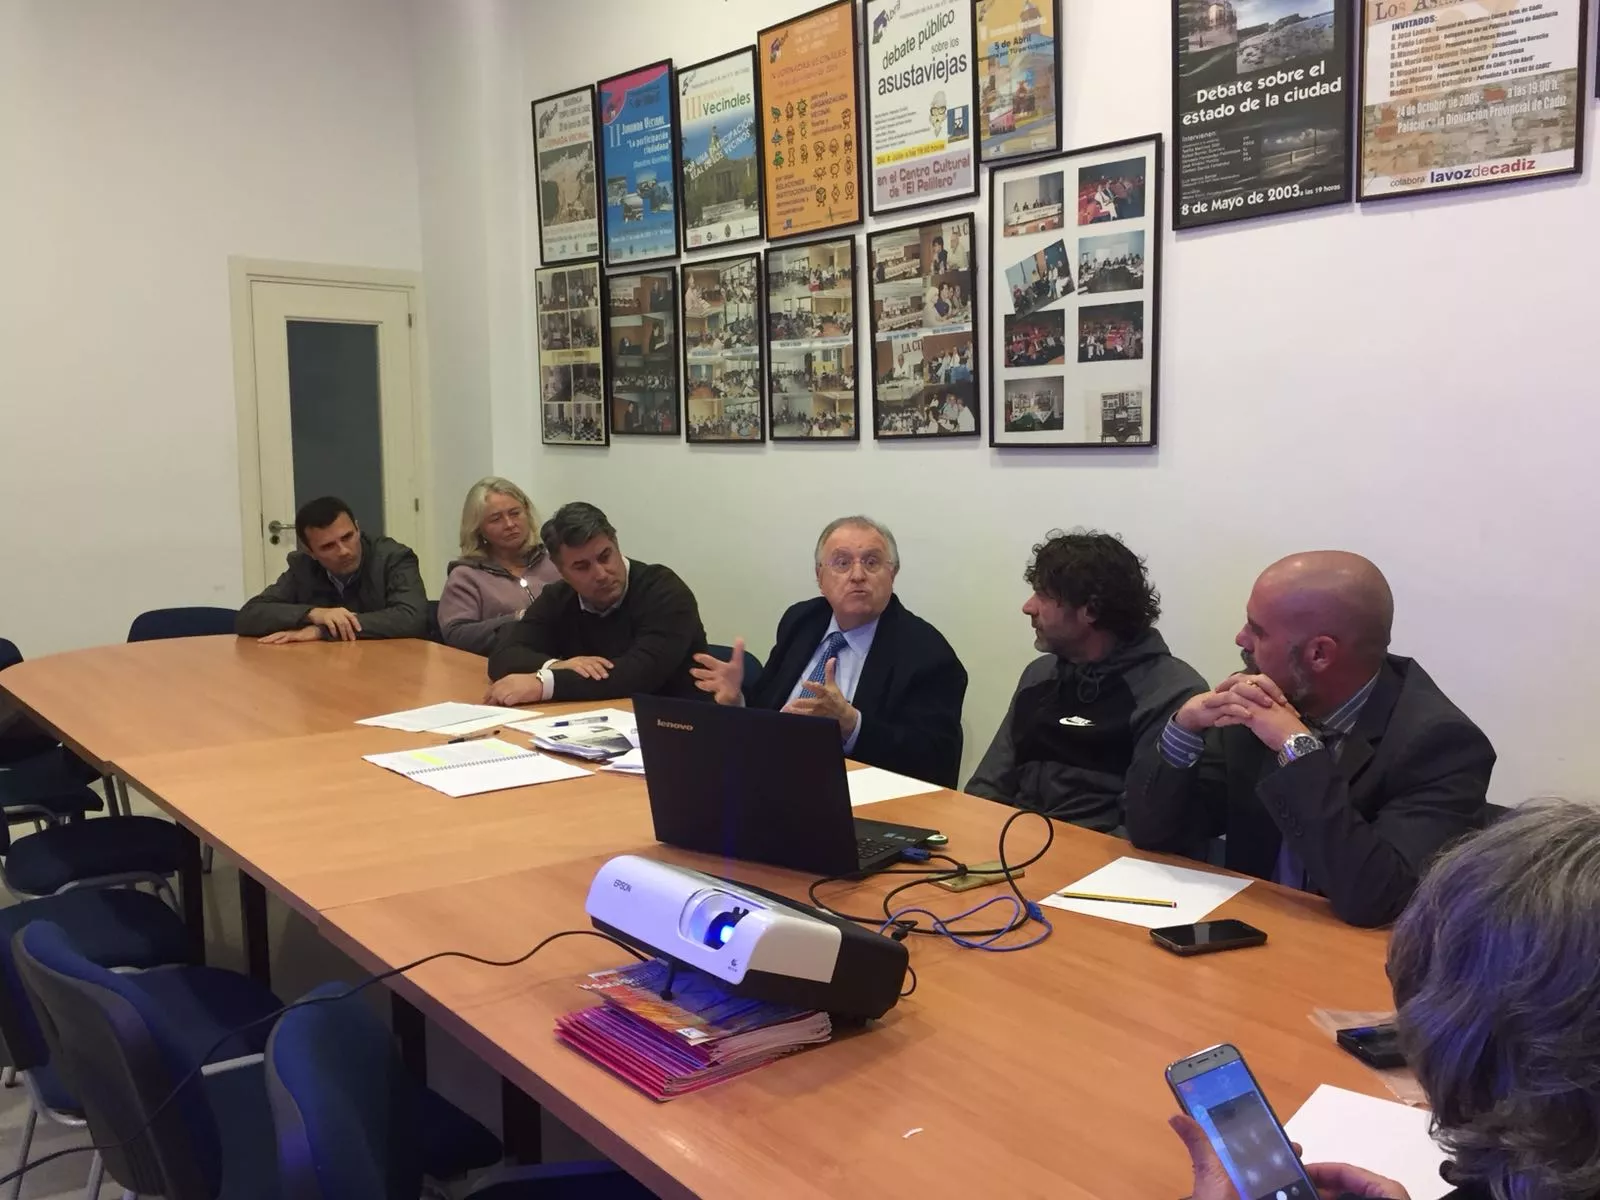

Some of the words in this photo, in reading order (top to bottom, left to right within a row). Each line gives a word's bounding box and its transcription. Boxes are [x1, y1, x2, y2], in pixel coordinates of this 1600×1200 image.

[1391, 14, 1438, 31] INVITADOS:
[882, 36, 916, 70] debate
[918, 9, 955, 50] público
[931, 40, 949, 54] sobre
[949, 37, 960, 48] los
[994, 41, 1000, 50] 5
[1001, 39, 1011, 48] de
[1013, 34, 1032, 46] Abril
[878, 53, 967, 96] asustaviejas
[1196, 80, 1253, 104] Debate
[1257, 68, 1305, 90] sobre
[1309, 60, 1325, 77] el
[1182, 103, 1235, 126] estado
[1239, 97, 1260, 113] de
[1265, 93, 1280, 107] la
[1283, 77, 1342, 103] ciudad
[1507, 87, 1513, 98] a
[1513, 85, 1527, 97] las
[702, 91, 751, 116] Vecinales
[1531, 97, 1543, 112] de
[877, 175, 888, 186] en
[889, 170, 897, 184] el
[899, 166, 931, 181] Centro
[932, 153, 970, 174] Cultural
[1390, 175, 1425, 188] colabora
[1430, 158, 1536, 183] lavozdecadiz
[889, 185, 900, 198] de
[1181, 203, 1189, 216] 8
[1192, 201, 1209, 213] de
[1211, 196, 1245, 211] Mayo
[1247, 191, 1264, 205] de
[1267, 184, 1300, 202] 2003
[1315, 186, 1323, 194] 19
[1323, 184, 1341, 192] horas
[656, 718, 694, 731] lenovo
[613, 878, 633, 892] EPSON
